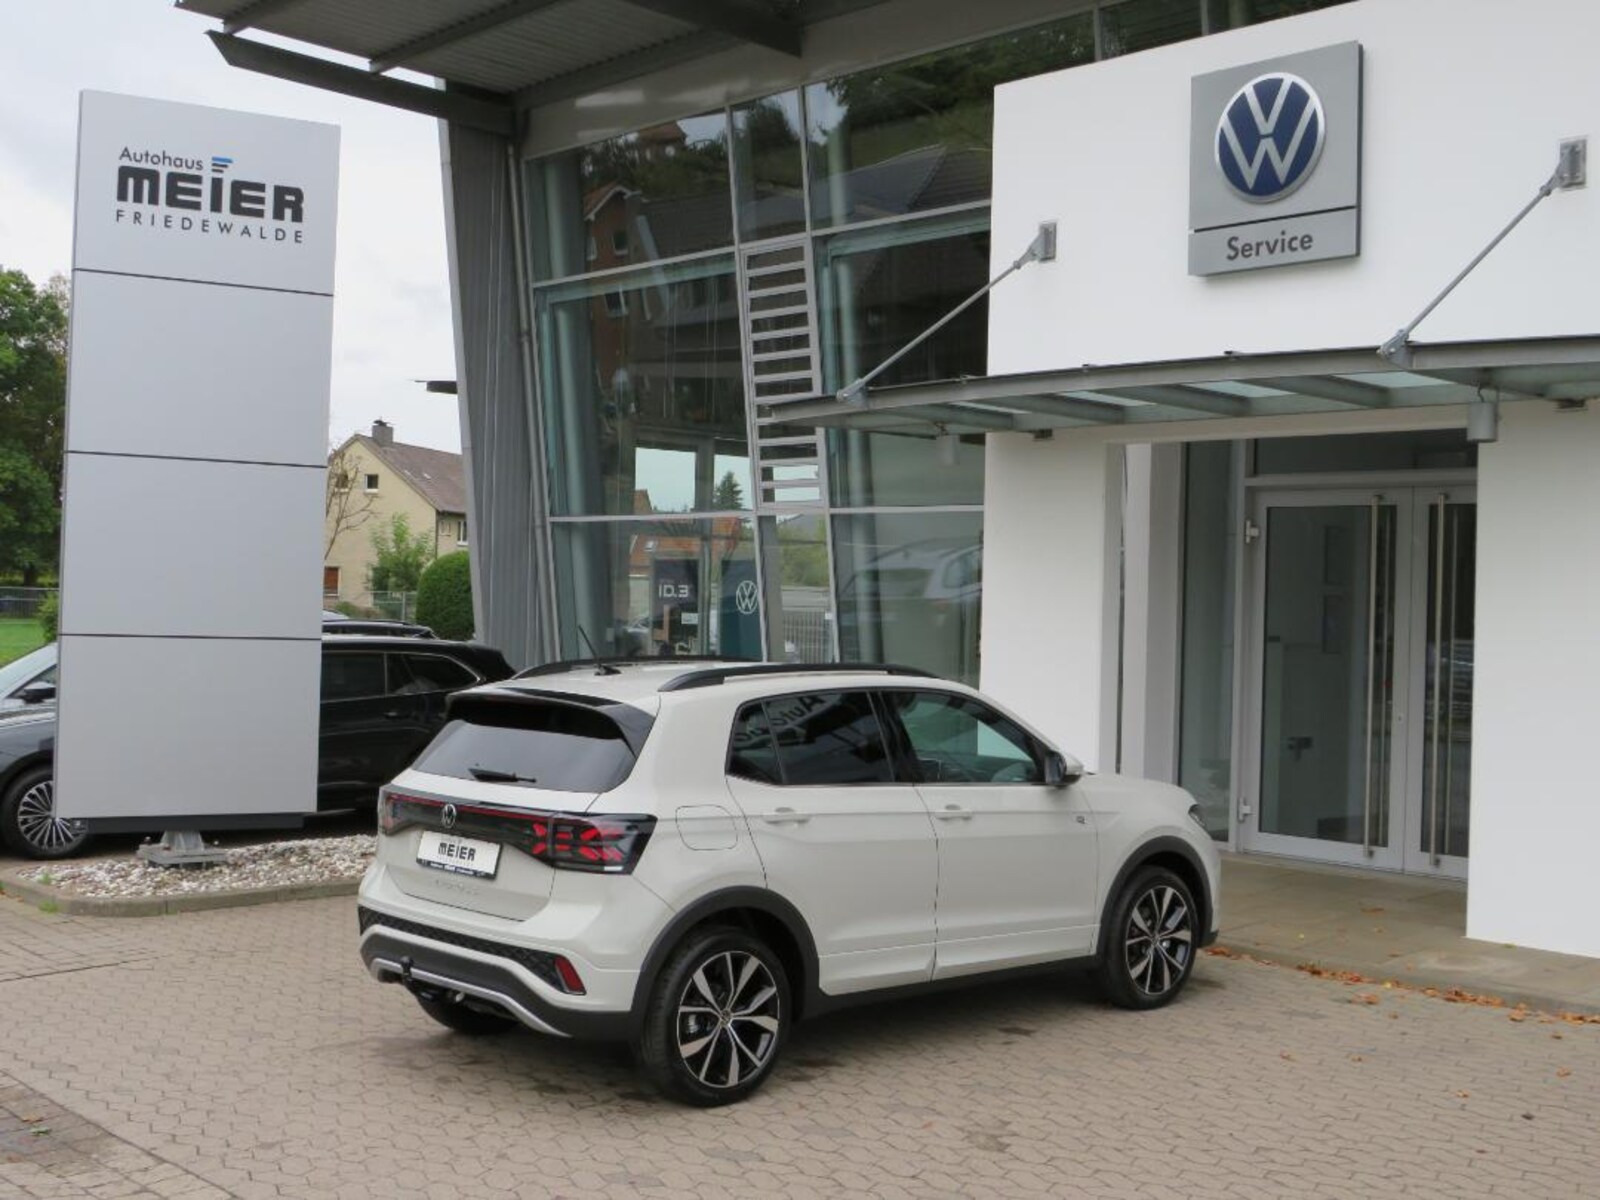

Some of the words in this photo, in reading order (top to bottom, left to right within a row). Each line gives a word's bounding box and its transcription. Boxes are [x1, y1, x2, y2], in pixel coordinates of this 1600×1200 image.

[118, 146, 204, 171] Autohaus
[116, 164, 305, 223] MEIER
[115, 208, 303, 244] FRIEDEWALDE
[1225, 230, 1314, 261] Service
[658, 583, 689, 599] ID.3
[438, 842, 477, 862] MEIER
